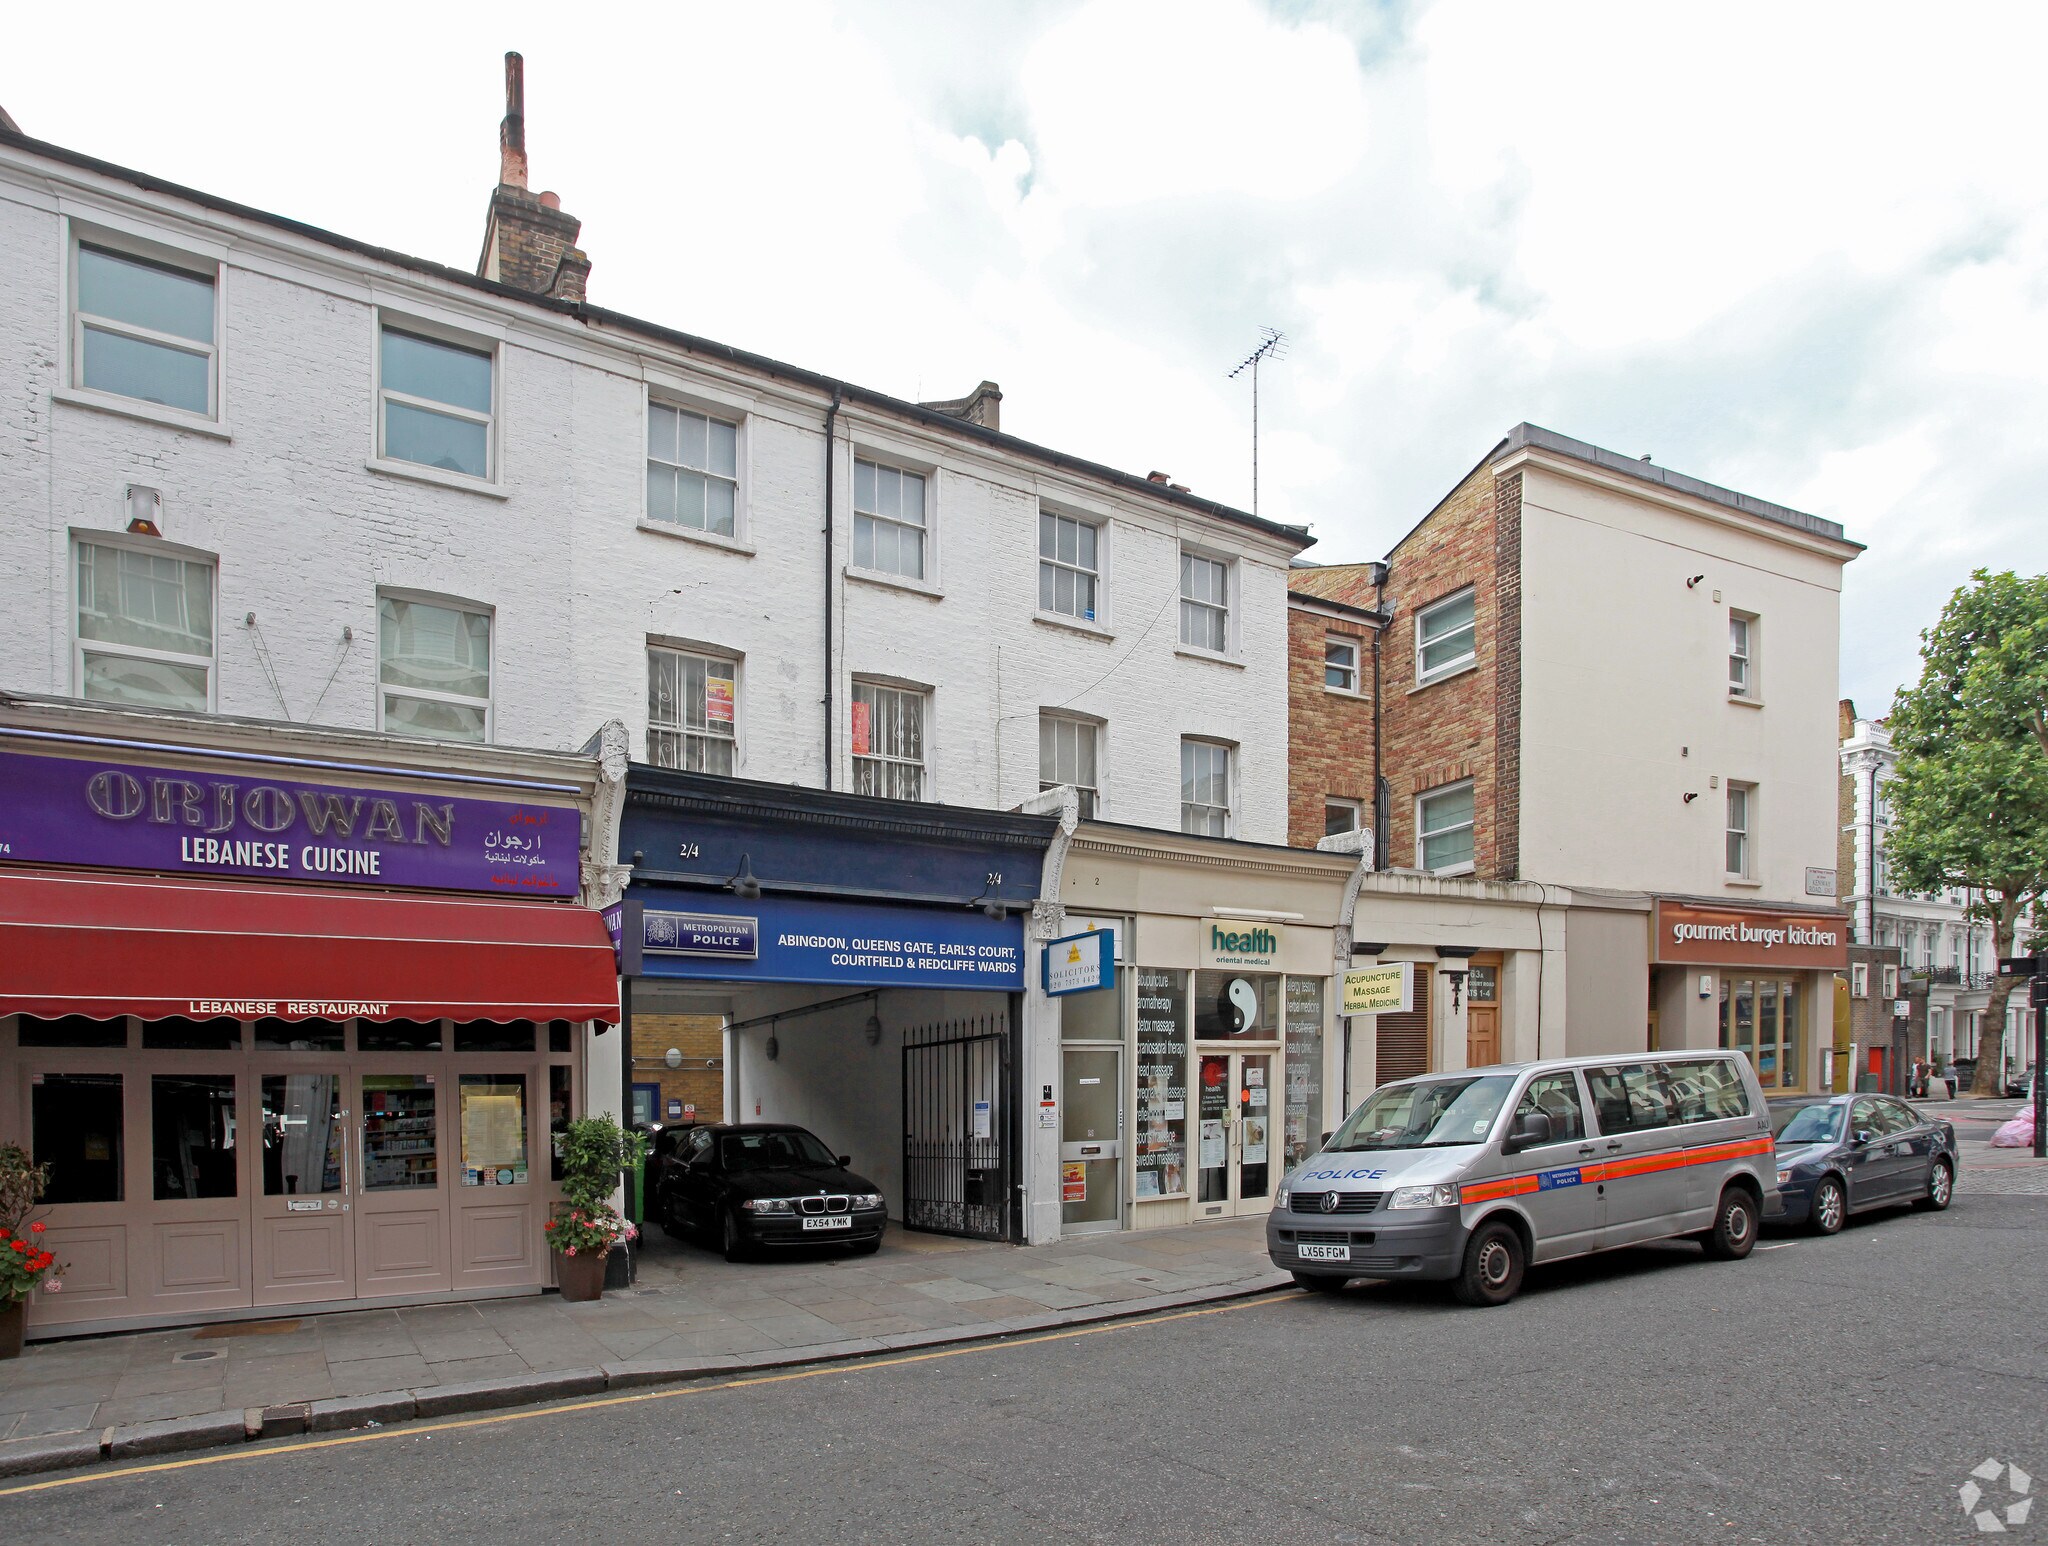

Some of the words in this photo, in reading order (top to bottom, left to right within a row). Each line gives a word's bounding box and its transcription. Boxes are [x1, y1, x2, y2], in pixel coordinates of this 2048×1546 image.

[85, 770, 455, 847] ORJOWAN
[181, 836, 289, 869] LEBANESE
[301, 845, 380, 875] CUISINE
[680, 842, 699, 858] 2/4
[986, 872, 1002, 886] 2/4
[1095, 878, 1100, 886] 2
[683, 923, 749, 935] METROPOLITAN
[1673, 922, 1738, 944] gourmet
[1739, 922, 1786, 948] burger
[1787, 925, 1837, 946] kitchen
[692, 934, 740, 946] POLICE
[1212, 924, 1277, 954] health
[778, 934, 849, 950] ABINGDON,
[852, 938, 901, 952] QUEENS
[903, 941, 937, 956] GATE,
[939, 943, 976, 956] EARL'S
[978, 946, 1017, 960] COURT,
[831, 953, 904, 968] COURTFIELD
[906, 957, 915, 969] &
[918, 958, 975, 971] REDCLIFFE
[978, 961, 1017, 973] WARDS
[1216, 956, 1243, 964] oriental
[1244, 958, 1271, 966] medical
[1049, 965, 1101, 979] SOLICITORS
[1344, 971, 1401, 985] ACUPUNCTURE
[1353, 985, 1391, 997] MASSAGE
[189, 1001, 277, 1014] LEBANESE
[287, 1003, 389, 1015] RESTAURANT
[1344, 1001, 1368, 1011] HERBAL
[1369, 998, 1400, 1008] MEDICINE
[1152, 1020, 1175, 1036] massage
[1150, 1065, 1174, 1080] massage
[1302, 1169, 1387, 1181] POLICE
[1556, 1177, 1576, 1185] POLICE
[806, 1218, 830, 1228] EX54
[832, 1217, 848, 1227] YMK
[1301, 1246, 1325, 1257] LX56
[1326, 1247, 1346, 1258] FGM
